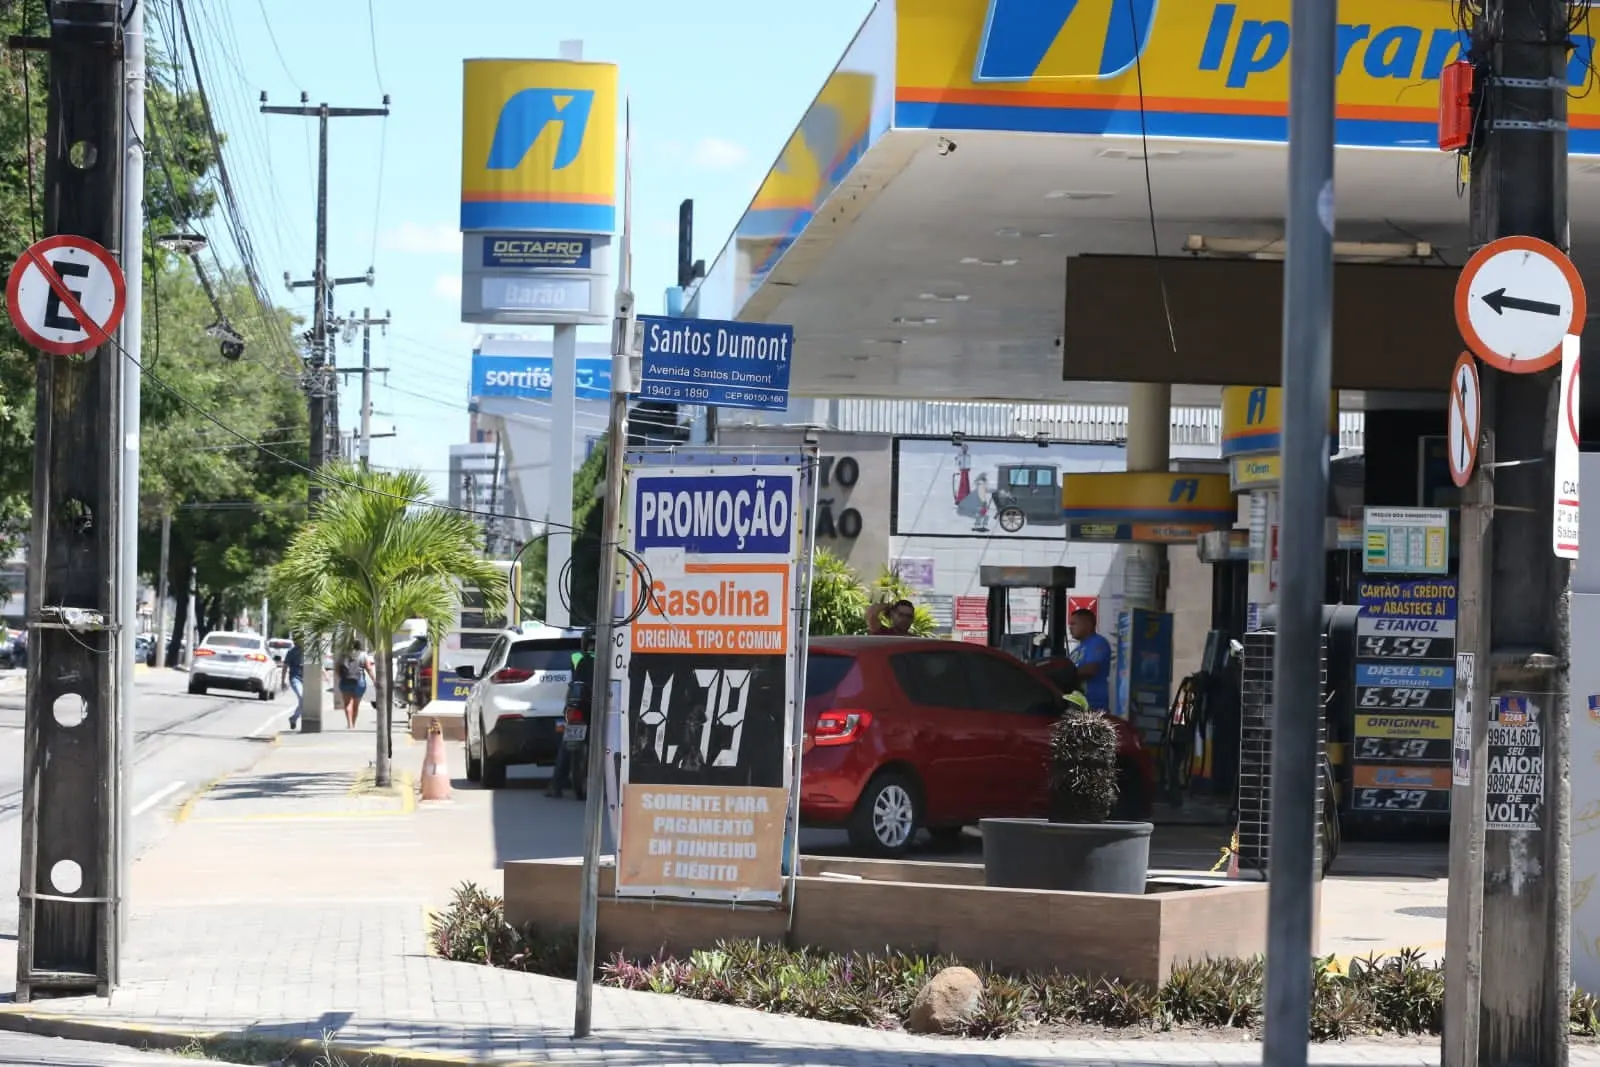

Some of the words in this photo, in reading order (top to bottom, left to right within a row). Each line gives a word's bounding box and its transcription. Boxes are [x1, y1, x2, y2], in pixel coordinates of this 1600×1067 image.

[1198, 3, 1597, 89] Iprana
[493, 241, 583, 256] OCTAPRO
[44, 260, 89, 331] E
[504, 282, 566, 305] Barão
[649, 324, 712, 356] Santos
[716, 329, 788, 361] Dumont
[486, 367, 554, 387] sorrifá
[648, 364, 690, 376] Avenida
[693, 368, 729, 380] Santos
[731, 371, 771, 383] Dumont
[647, 385, 671, 396] 1940
[674, 389, 680, 397] a
[685, 388, 709, 399] 1890
[725, 392, 741, 400] CEP
[1563, 481, 1579, 495] CA
[640, 479, 788, 550] PROMOÇÃO
[646, 580, 769, 617] Gasolina
[1361, 583, 1400, 598] CARTÃO
[1414, 581, 1455, 599] CRÉDITO
[1383, 601, 1432, 616] ABASTECE
[1374, 619, 1440, 632] ETANOL
[637, 630, 693, 649] ORIGINAL
[696, 630, 724, 649] TIPO
[726, 631, 735, 649] C
[737, 631, 782, 650] COMUM
[1365, 637, 1432, 657] 4.59
[1367, 665, 1416, 677] DIESEL
[454, 687, 470, 696] BA
[1360, 688, 1431, 707] 6.99
[1367, 718, 1440, 729] ORIGINAL
[1488, 728, 1540, 745] 99614.607
[1507, 747, 1526, 756] SEU
[1488, 756, 1541, 773] AMOR
[1487, 774, 1542, 793] 98964.4573
[641, 793, 721, 812] SOMENTE
[725, 796, 769, 813] PARA
[1360, 789, 1428, 809] 5.29
[1507, 794, 1524, 803] DE
[653, 816, 754, 835] PAGAMENTO
[649, 838, 672, 855] EM
[676, 840, 757, 859] DINHEIRO
